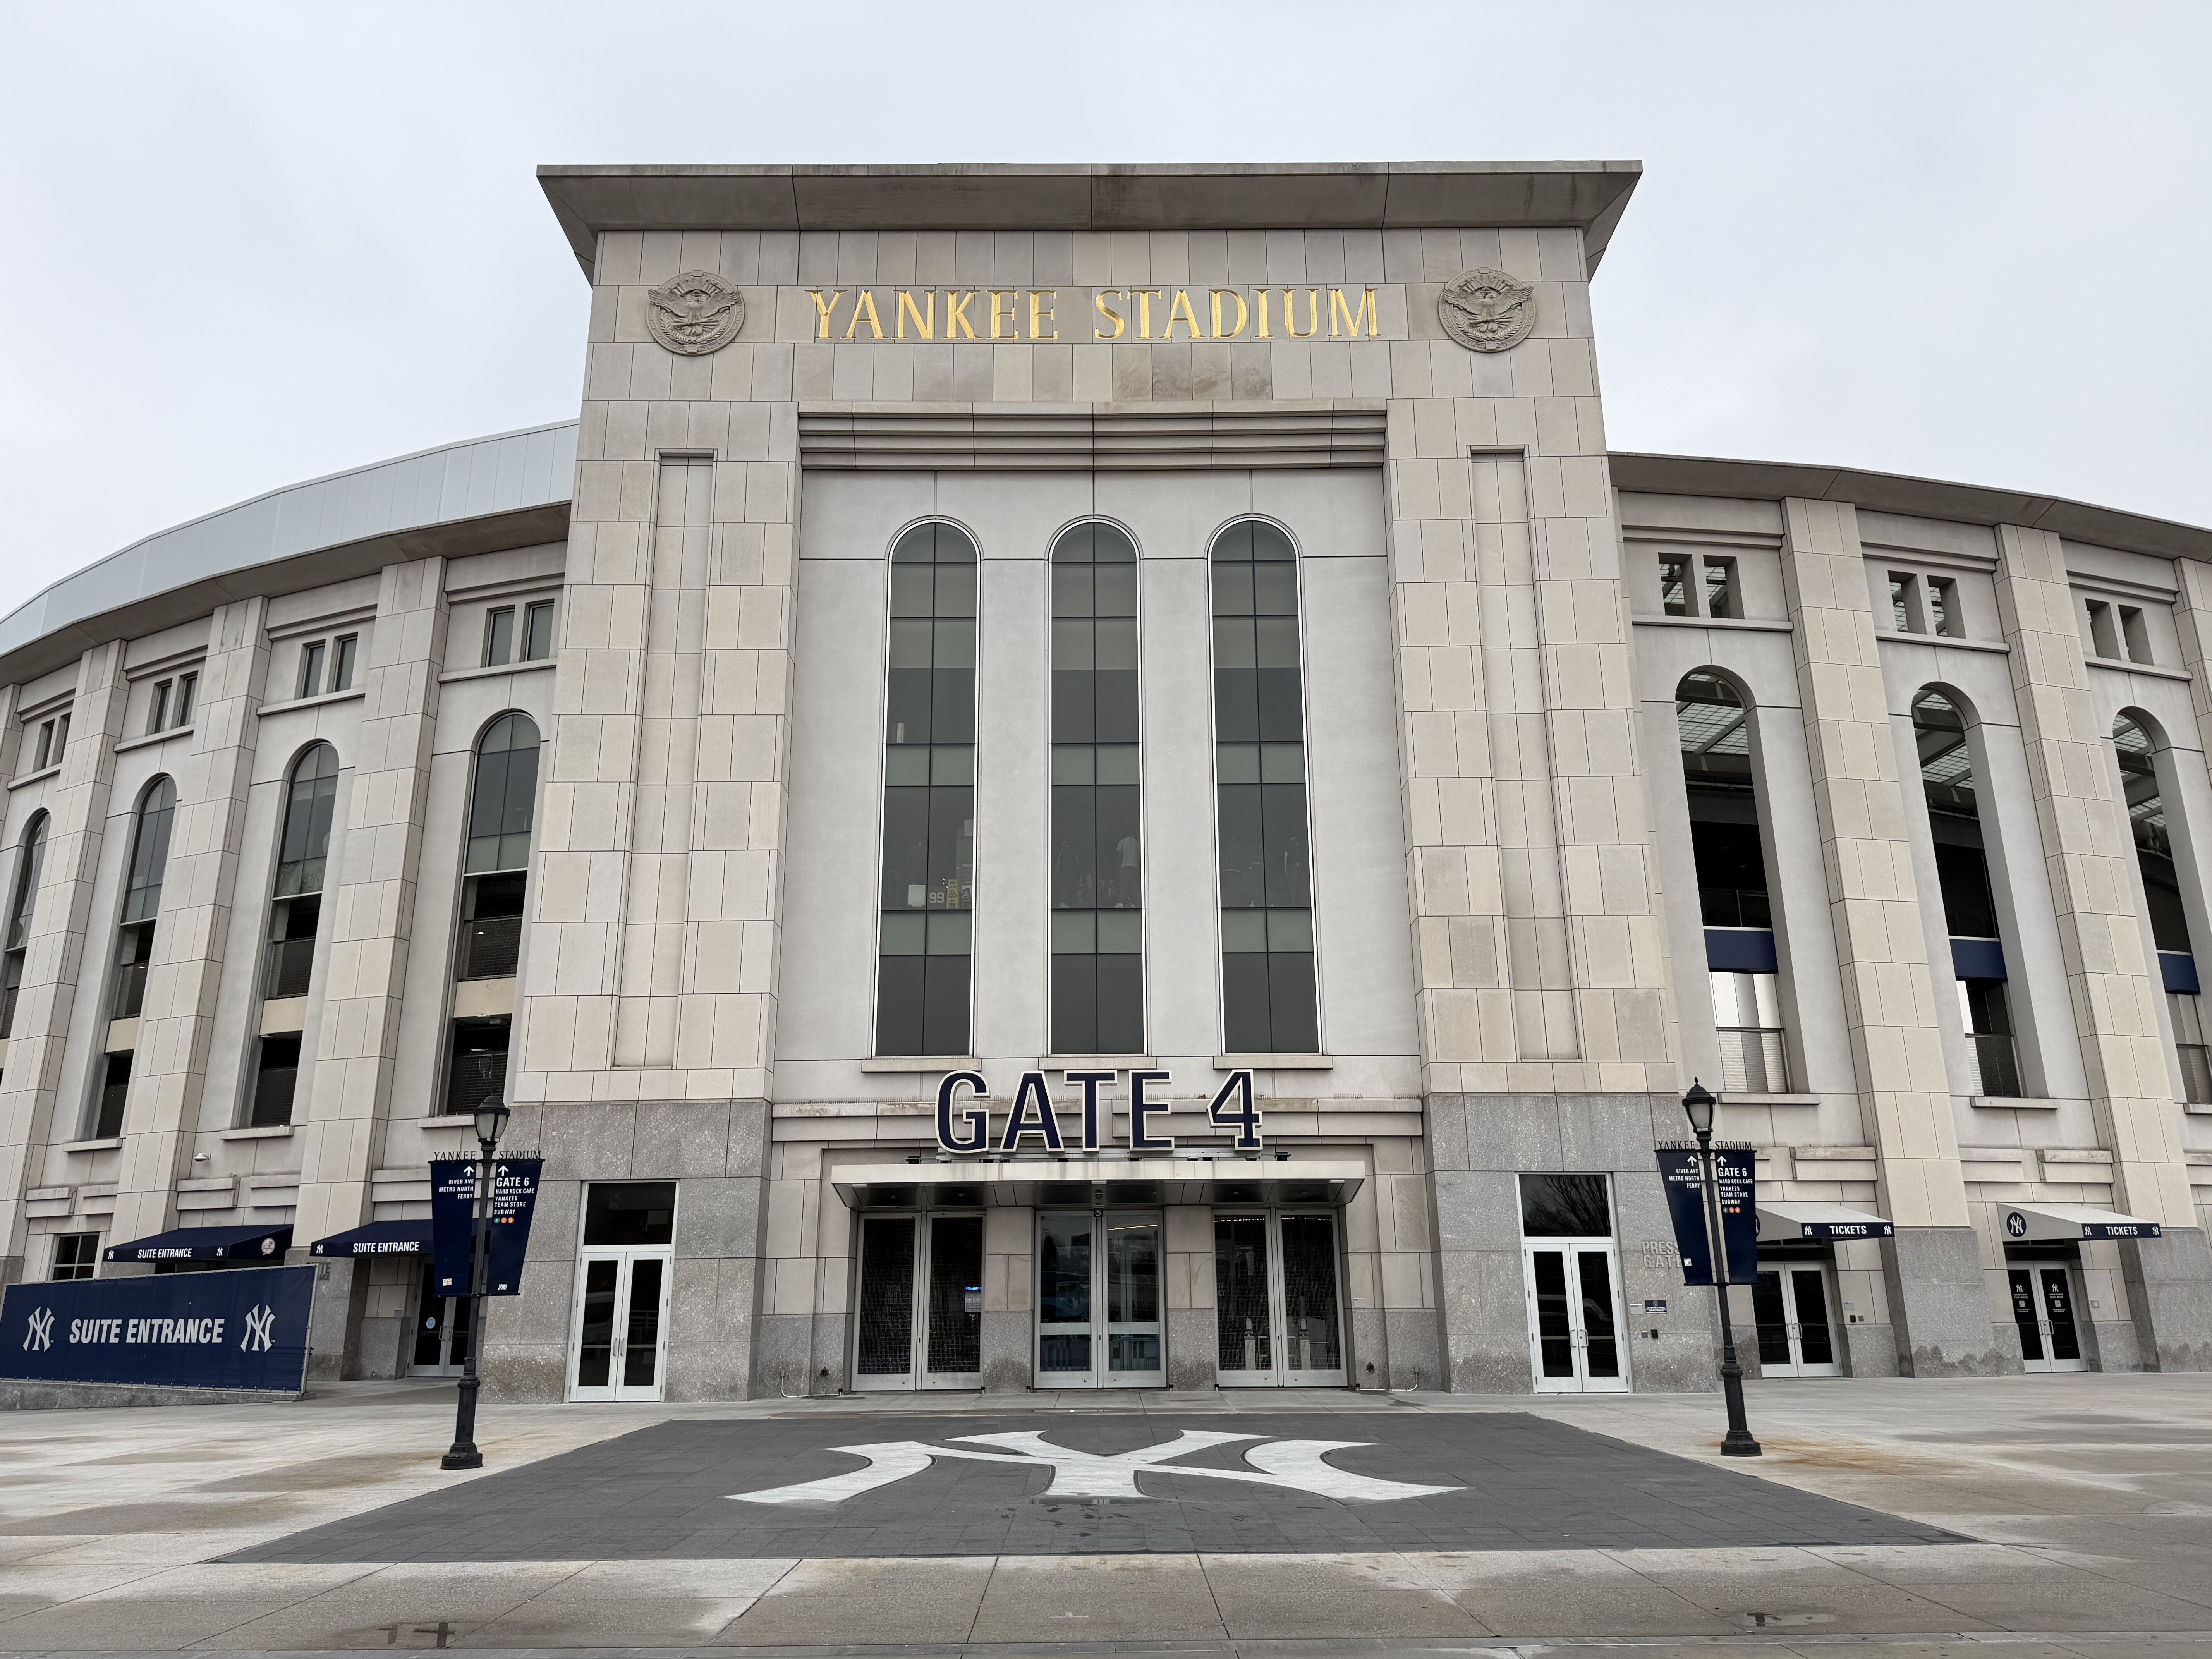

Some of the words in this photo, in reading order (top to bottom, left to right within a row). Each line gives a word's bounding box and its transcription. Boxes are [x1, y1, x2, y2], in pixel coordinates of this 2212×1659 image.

[804, 289, 1058, 340] YANKEE
[1094, 287, 1382, 339] STADIUM
[934, 1069, 1175, 1153] GATE
[1207, 1069, 1262, 1151] 4
[1657, 1140, 1695, 1150] YANKEE
[1715, 1141, 1752, 1150] STADIUM
[434, 1151, 476, 1161] YANKEE
[499, 1150, 541, 1160] STADIUM
[1718, 1168, 1740, 1177] GATE
[1742, 1168, 1747, 1177] 6
[496, 1177, 521, 1187] GATE
[524, 1177, 529, 1186] 6
[1829, 1225, 1867, 1235] TICKETS
[2106, 1226, 2138, 1235] TICKETS
[353, 1243, 376, 1253] SUITE
[378, 1241, 420, 1252] ENTRANCE
[1642, 1241, 1680, 1254] PRESS
[137, 1249, 156, 1259] SUITE
[158, 1248, 192, 1258] ENTRANCE
[1644, 1255, 1683, 1268] GATE
[23, 1306, 55, 1352] NY
[69, 1319, 122, 1343] SUITE
[126, 1318, 225, 1343] ENTRANCE
[240, 1304, 276, 1352] NY
